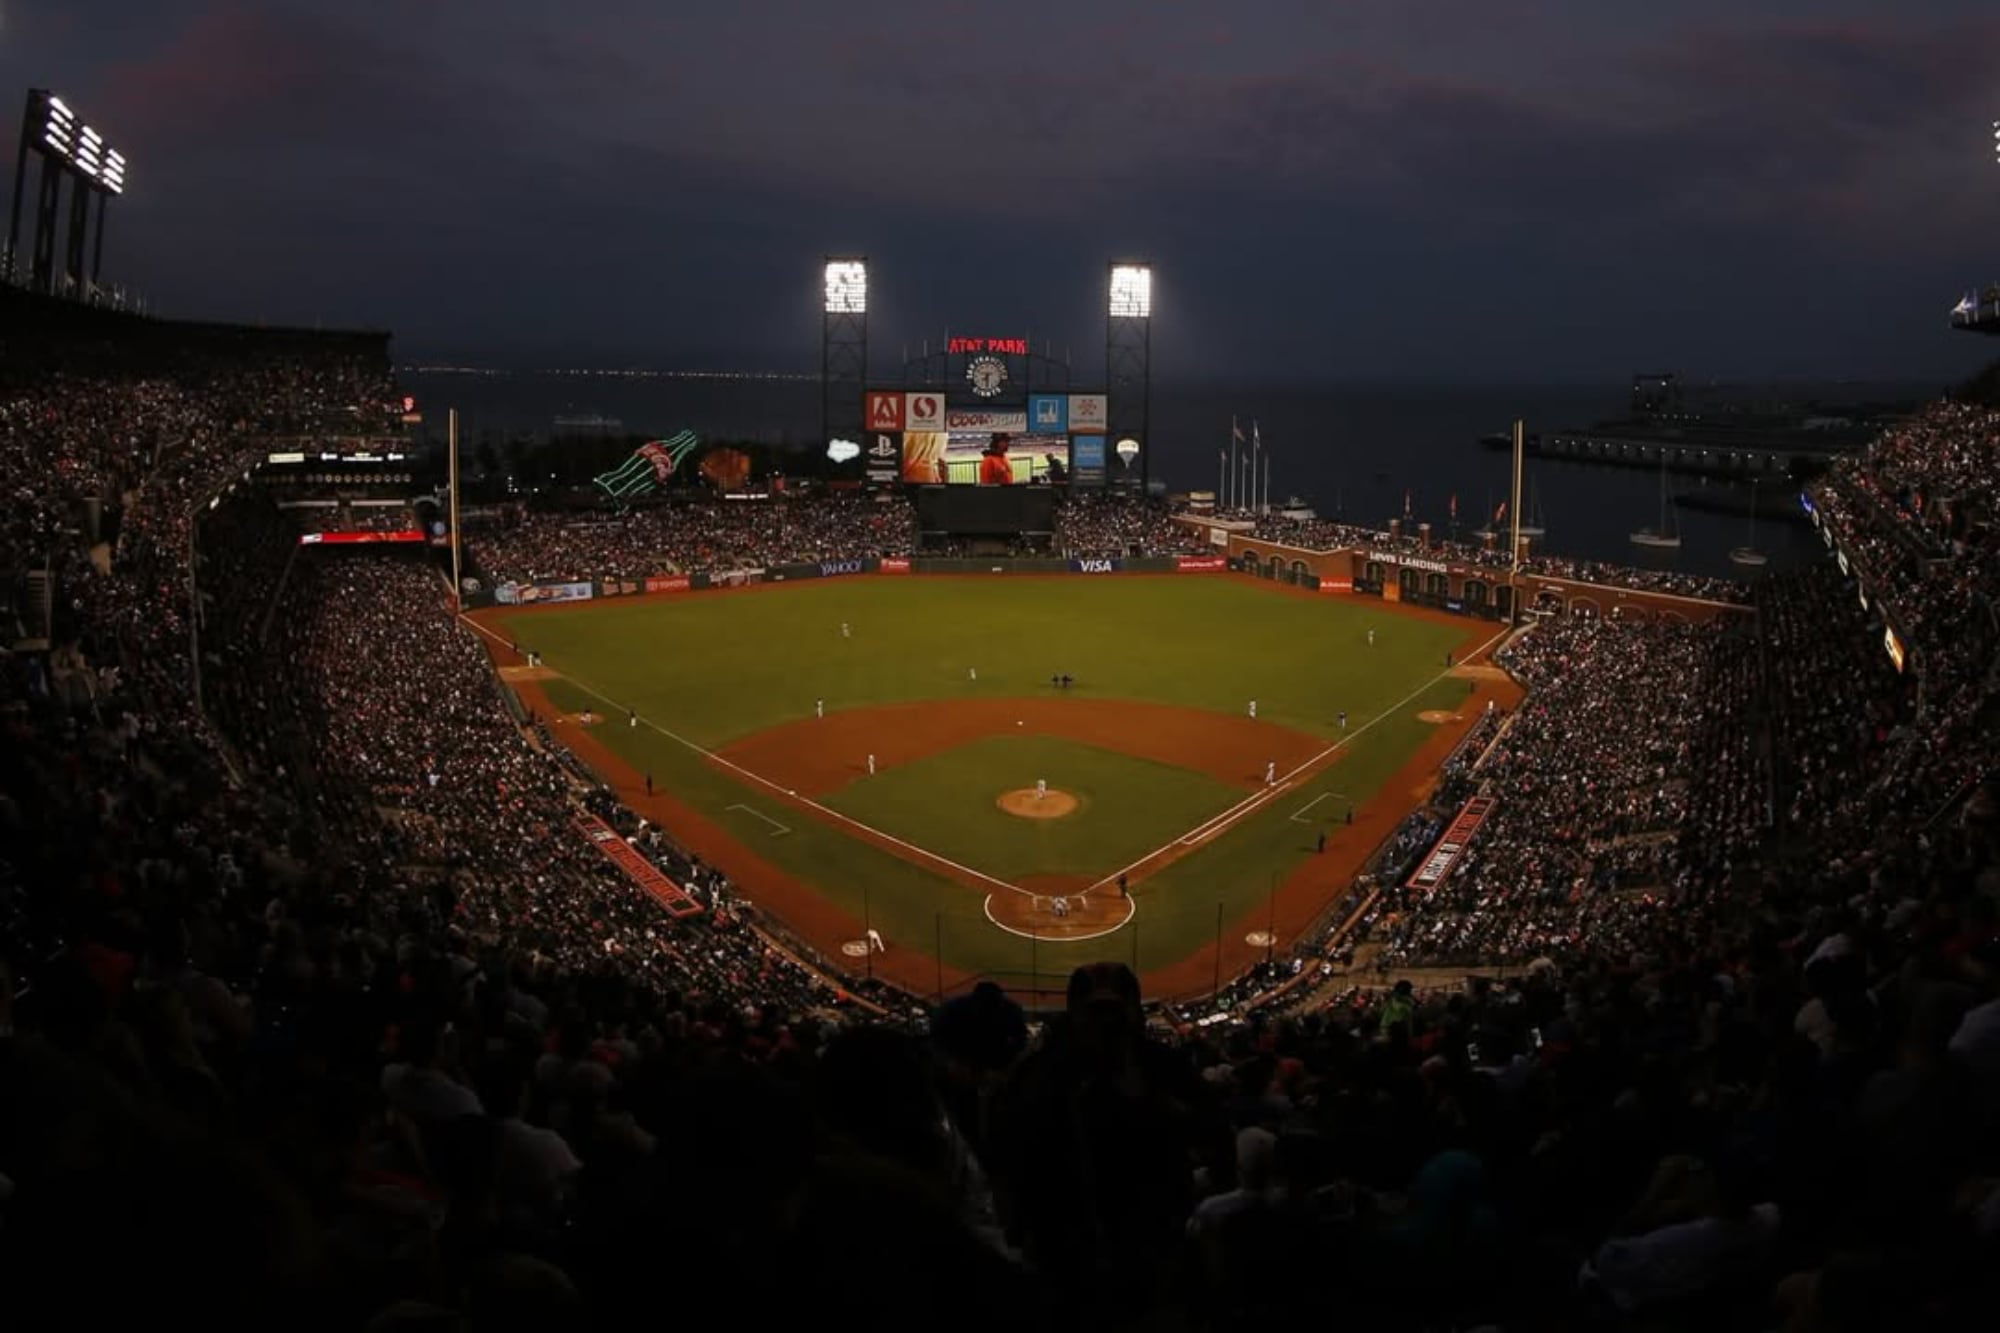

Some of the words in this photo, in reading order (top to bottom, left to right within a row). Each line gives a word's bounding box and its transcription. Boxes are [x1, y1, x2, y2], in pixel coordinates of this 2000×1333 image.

[949, 338, 982, 354] AT&T
[987, 338, 1026, 355] PARK
[1080, 560, 1112, 573] VISA
[1399, 556, 1447, 573] LANDING
